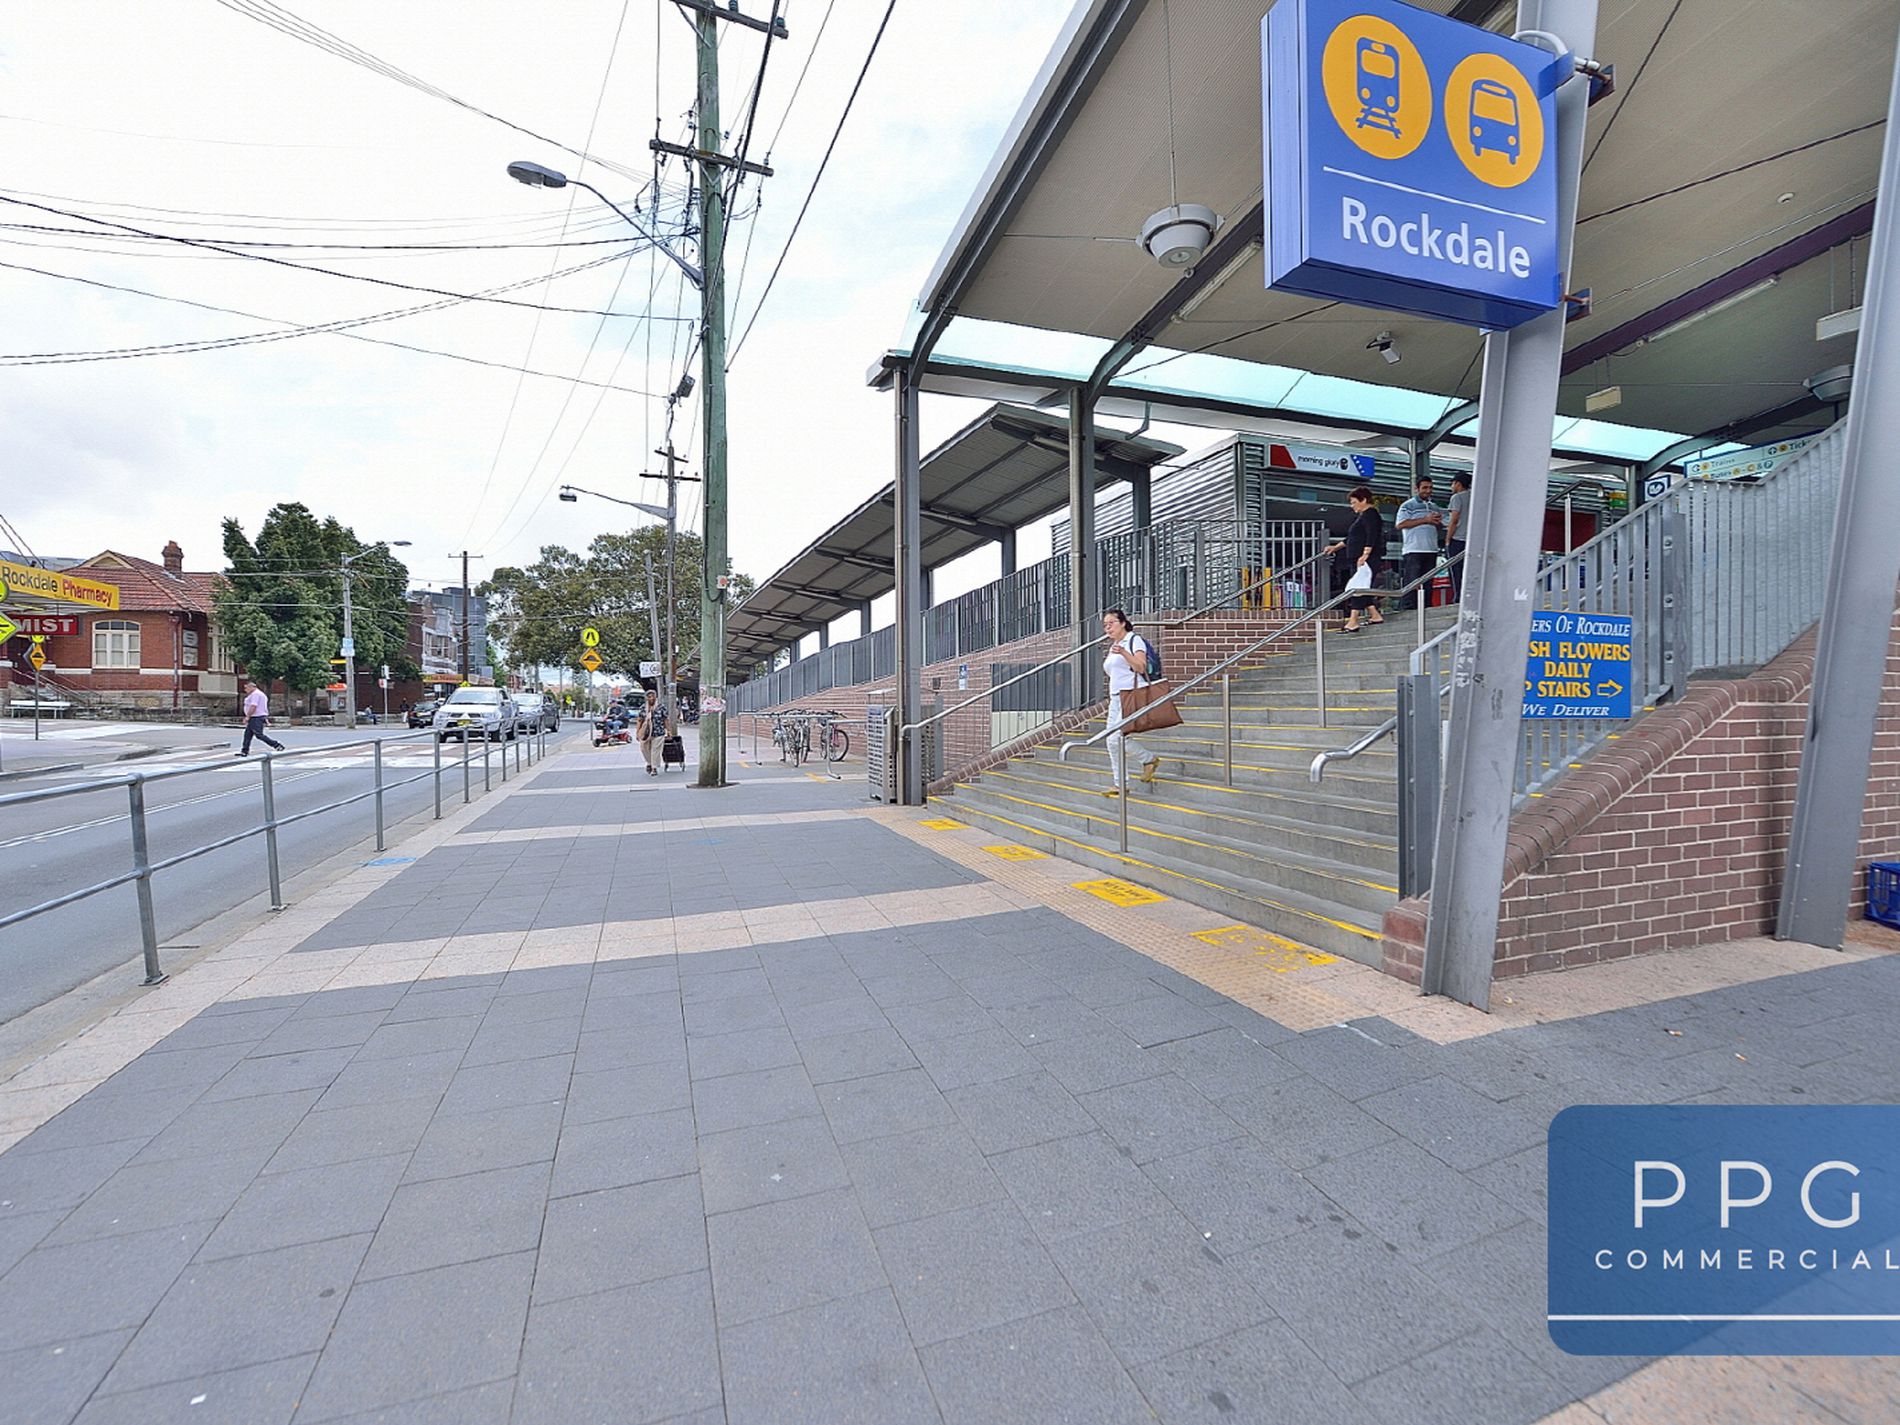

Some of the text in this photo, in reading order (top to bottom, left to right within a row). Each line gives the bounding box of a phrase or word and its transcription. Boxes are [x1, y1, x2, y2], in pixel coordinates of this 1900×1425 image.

[1341, 196, 1531, 279] Rockdale
[1, 565, 113, 607] Rockdale Pharmacy
[1528, 641, 1632, 661] SH FLOWERS
[1544, 661, 1592, 678] DAILY
[1537, 681, 1592, 698] STAIRS
